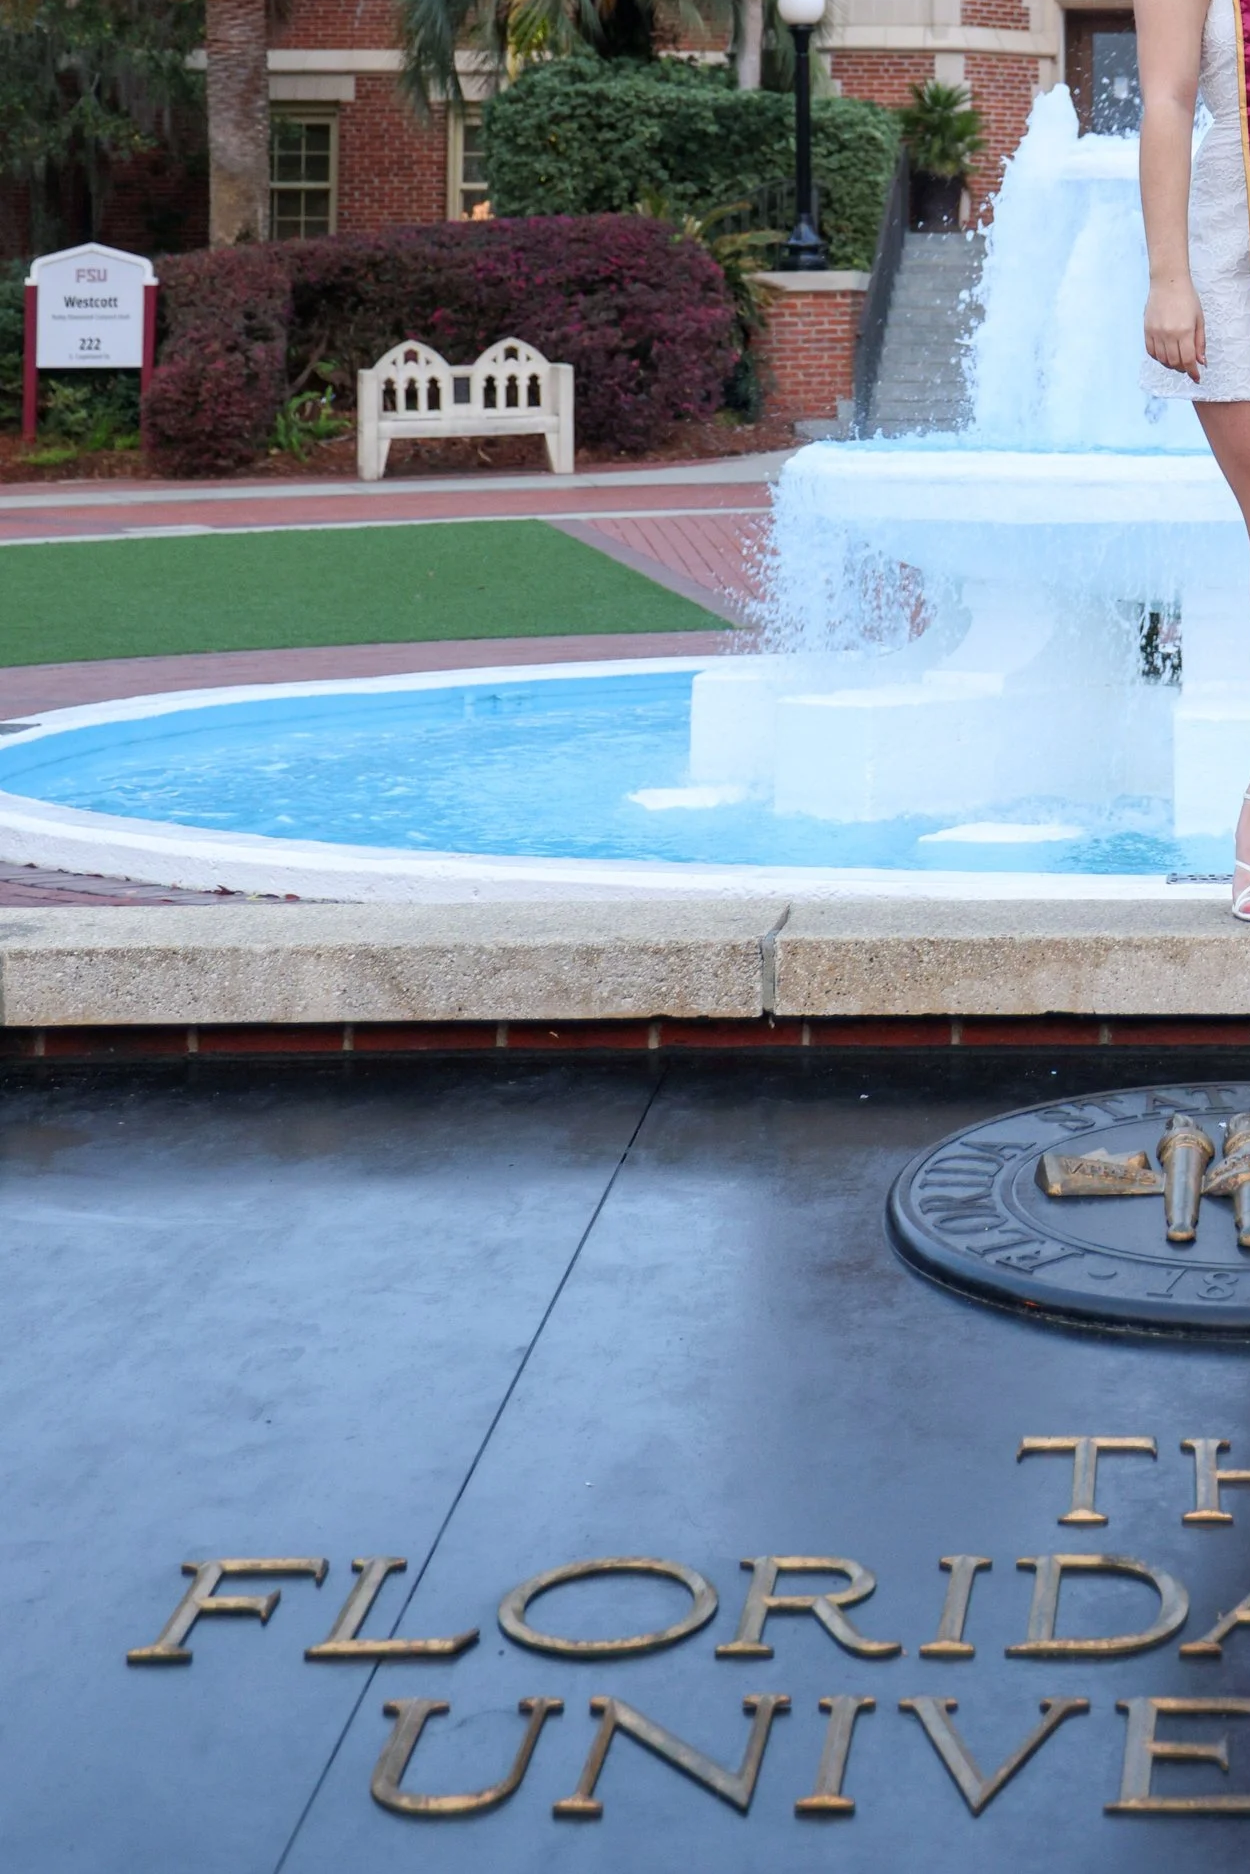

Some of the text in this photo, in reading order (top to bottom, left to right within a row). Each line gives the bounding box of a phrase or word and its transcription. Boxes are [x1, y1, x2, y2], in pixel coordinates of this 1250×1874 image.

[75, 268, 108, 283] FSU
[63, 296, 119, 308] Westcott
[79, 337, 101, 351] 222
